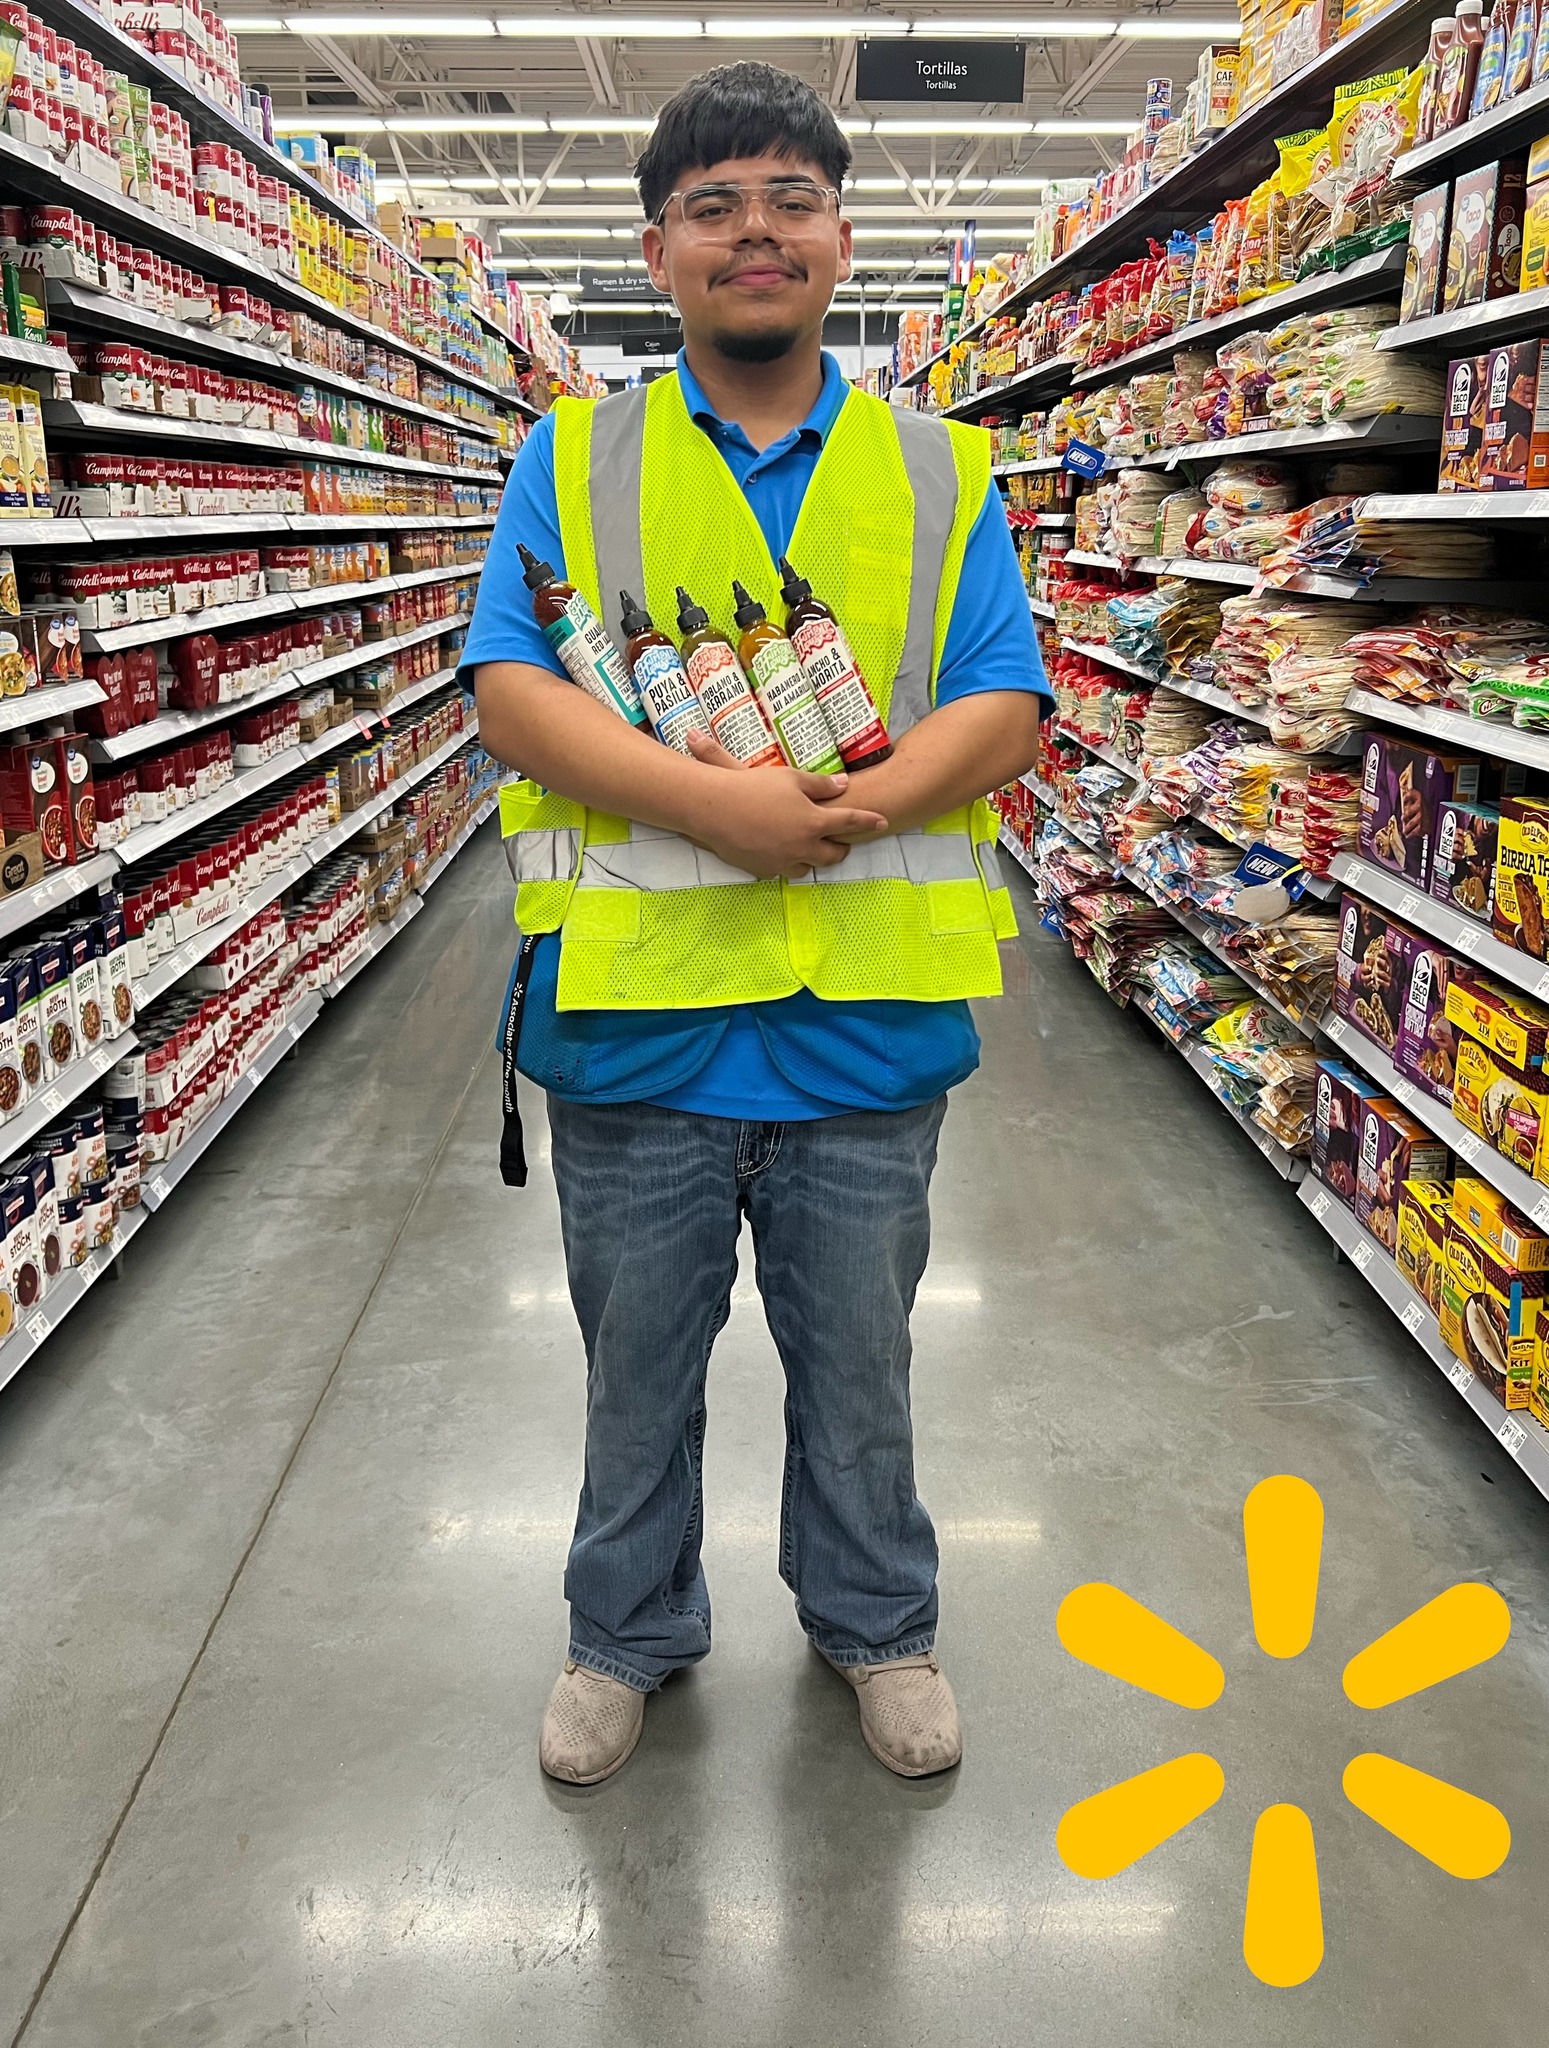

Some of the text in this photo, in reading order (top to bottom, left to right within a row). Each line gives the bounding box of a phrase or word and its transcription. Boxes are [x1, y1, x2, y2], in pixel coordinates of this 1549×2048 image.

[916, 60, 968, 75] Tortillas
[926, 80, 956, 90] Tortillas
[1466, 208, 1481, 224] Taco
[1504, 228, 1512, 248] Taco
[592, 278, 617, 286] Ramen
[626, 278, 636, 286] dry
[1492, 384, 1506, 394] TACO
[1452, 403, 1466, 412] BELL
[1453, 394, 1468, 403] TACO
[1492, 394, 1504, 404] BELL
[1069, 449, 1090, 466] NEW
[592, 640, 604, 655] RED
[806, 648, 840, 678] ANCHO &
[810, 660, 846, 691] MORITA
[648, 672, 686, 703] PUYA &
[702, 672, 740, 703] POBLANO &
[766, 672, 800, 702] HABANERO
[654, 686, 692, 716] PASILLA
[706, 682, 744, 715] SERRANO
[1441, 836, 1453, 846] TACO
[1522, 826, 1549, 845] OLD EL PASO
[1248, 858, 1278, 876] NEW
[1500, 845, 1536, 874] BIRRIA
[4, 861, 25, 878] Great
[77, 975, 94, 994] BROTH
[1412, 980, 1428, 997] TACO
[46, 998, 67, 1018] BROTH
[1412, 991, 1426, 1007] BELL
[504, 998, 519, 1113] Associate of the month
[1460, 1044, 1488, 1074] OLD EL PASO
[1458, 1072, 1471, 1090] KIT
[1365, 1140, 1376, 1156] TACO
[1364, 1150, 1375, 1166] BELL
[38, 1204, 55, 1231] STOCK
[10, 1231, 31, 1259] STOCK
[1401, 1232, 1410, 1248] KIT
[1450, 1245, 1481, 1288] OLD EL PASO
[1444, 1271, 1456, 1290] KIT
[1511, 1360, 1530, 1368] KIT
